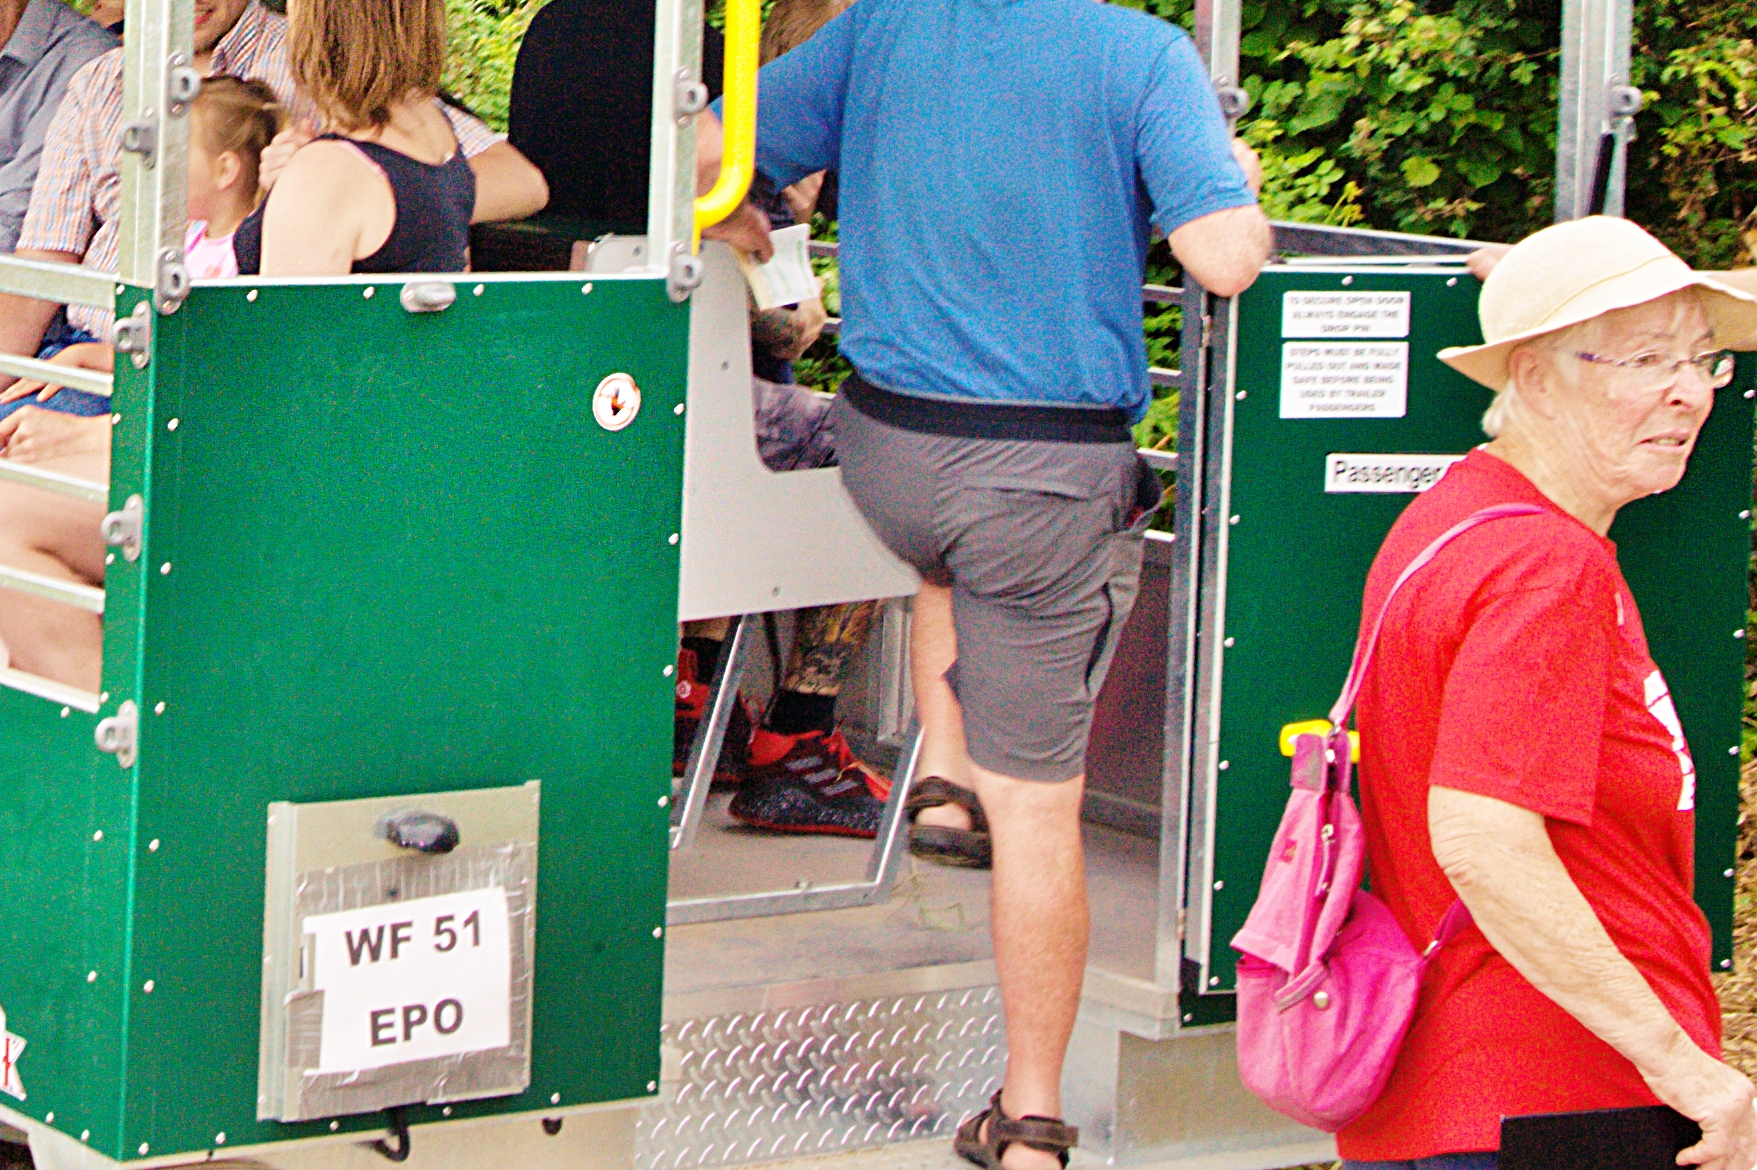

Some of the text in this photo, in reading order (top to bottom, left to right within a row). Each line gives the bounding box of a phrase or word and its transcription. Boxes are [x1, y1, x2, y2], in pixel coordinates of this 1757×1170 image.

[1288, 296, 1404, 305] TO SECURE OPEN DOOR
[1292, 310, 1399, 319] ALWAYS ENGAGE THE
[1321, 324, 1370, 333] DROP PIN
[1289, 348, 1400, 357] STEPS MUST BE FULLY
[1285, 362, 1324, 371] PULLED
[1327, 362, 1347, 371] OUT
[1349, 362, 1369, 371] AND
[1293, 376, 1394, 384] SAFE BEFORE BEING
[1300, 389, 1386, 398] USED BY TRAILER
[1308, 403, 1375, 412] PASSENGERS
[1334, 460, 1442, 490] Passenger
[345, 909, 482, 966] WF 51
[369, 998, 464, 1048] EPO
